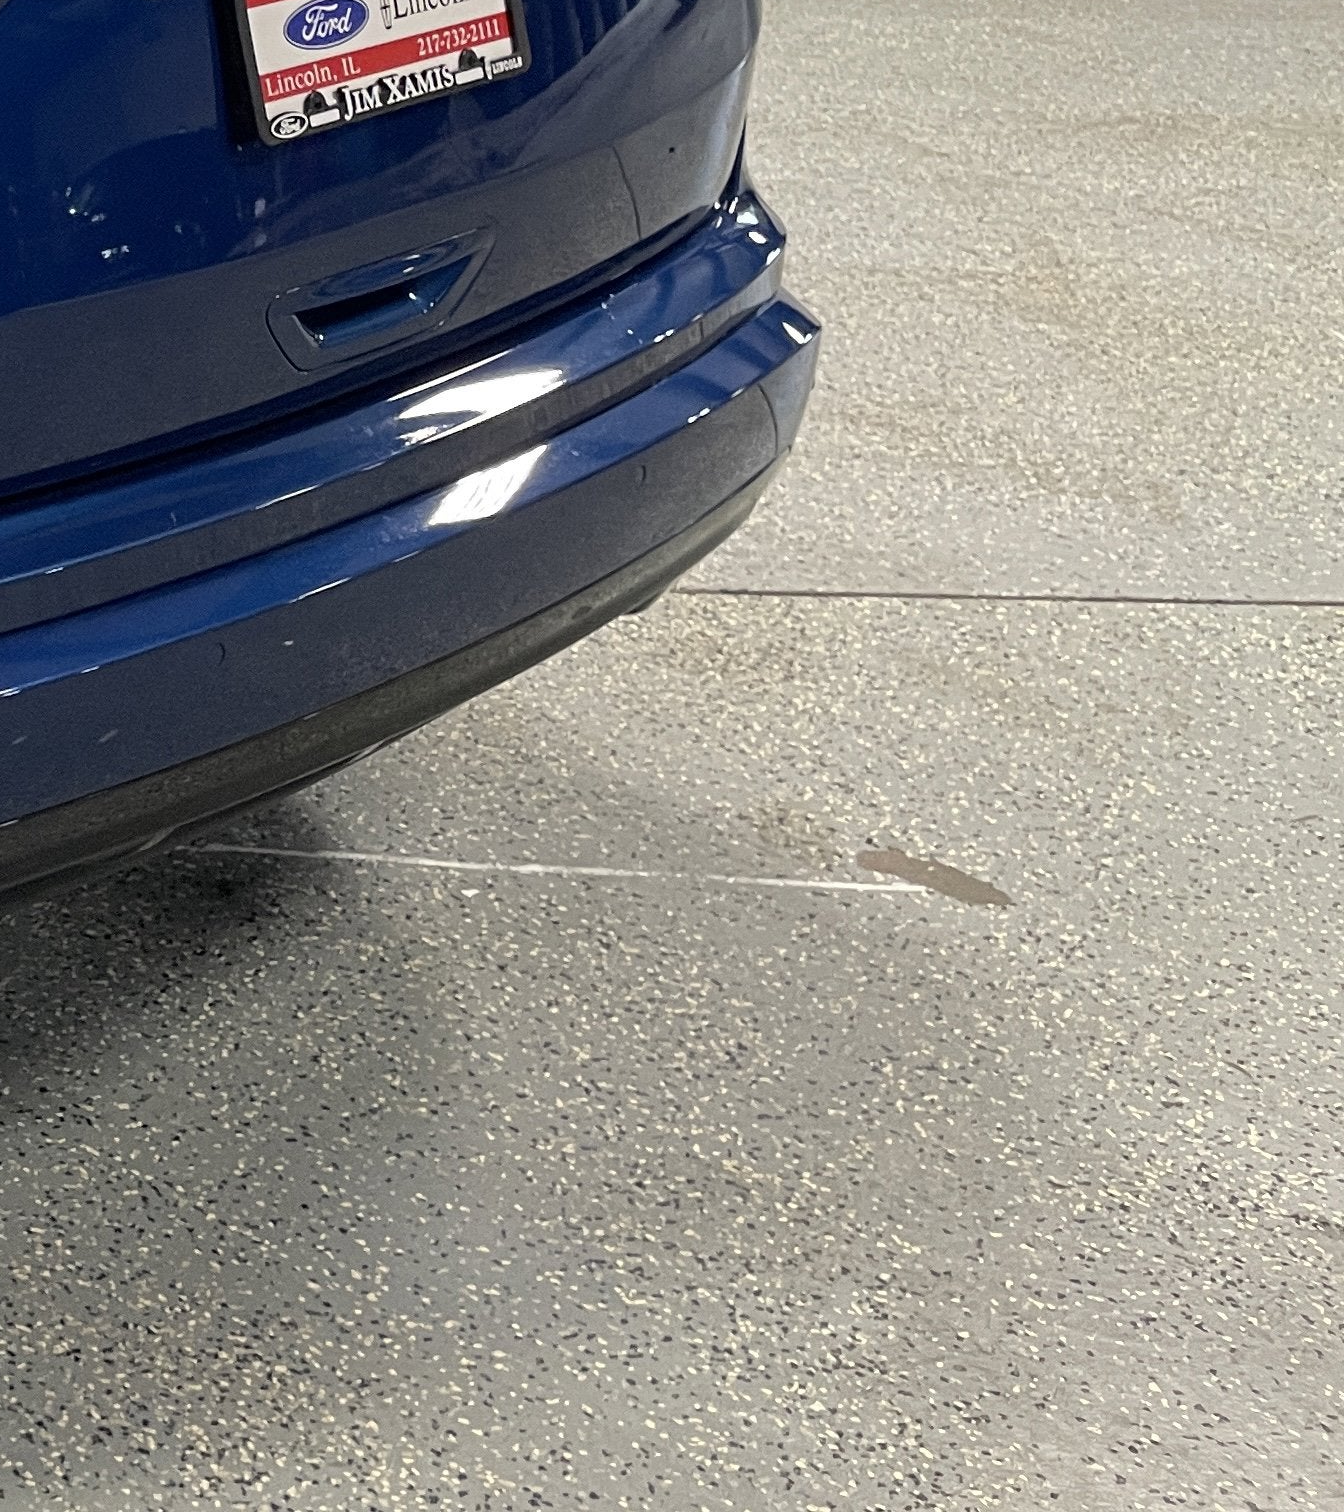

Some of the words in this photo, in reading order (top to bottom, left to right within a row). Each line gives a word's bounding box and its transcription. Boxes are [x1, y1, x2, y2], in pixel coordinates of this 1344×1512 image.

[302, 3, 353, 42] Ford
[265, 63, 338, 97] Lincoln,
[341, 56, 361, 77] IL
[341, 84, 383, 121] JIM
[382, 66, 454, 105] XAMIS
